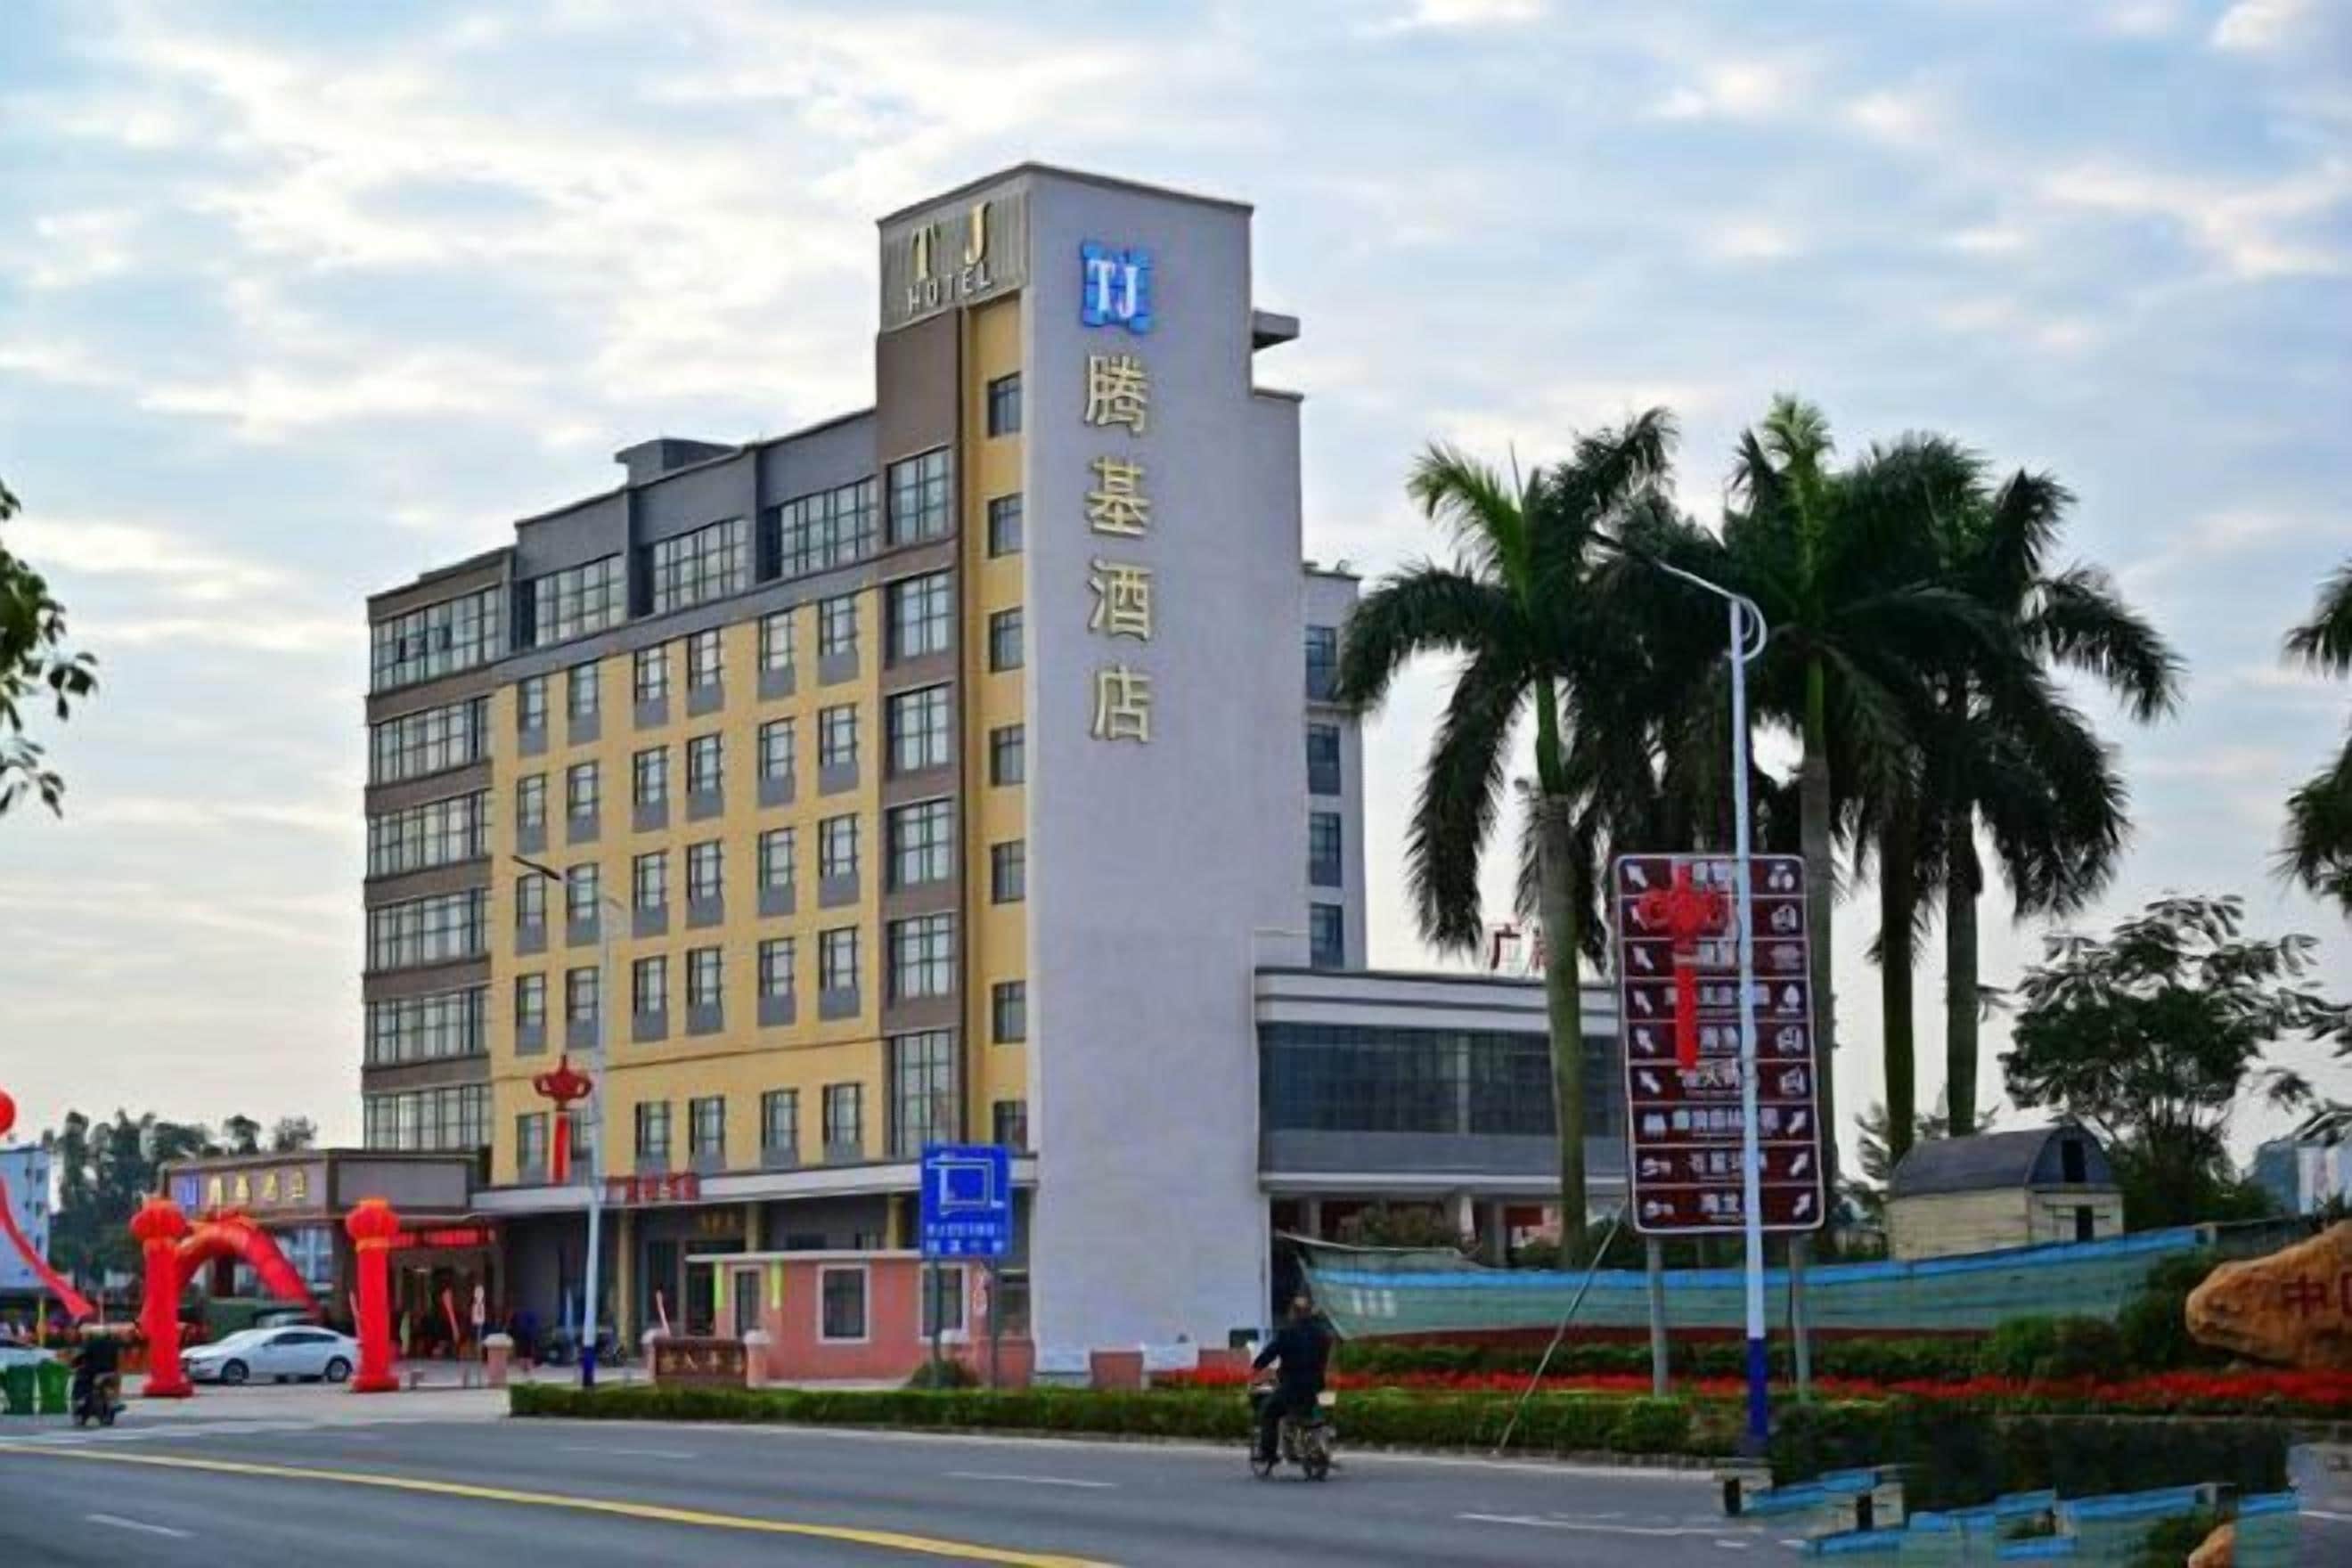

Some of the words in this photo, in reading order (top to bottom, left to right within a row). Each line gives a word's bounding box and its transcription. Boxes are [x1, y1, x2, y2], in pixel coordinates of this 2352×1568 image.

[907, 262, 992, 314] HOTEL
[1083, 354, 1152, 743] 腾基酒店
